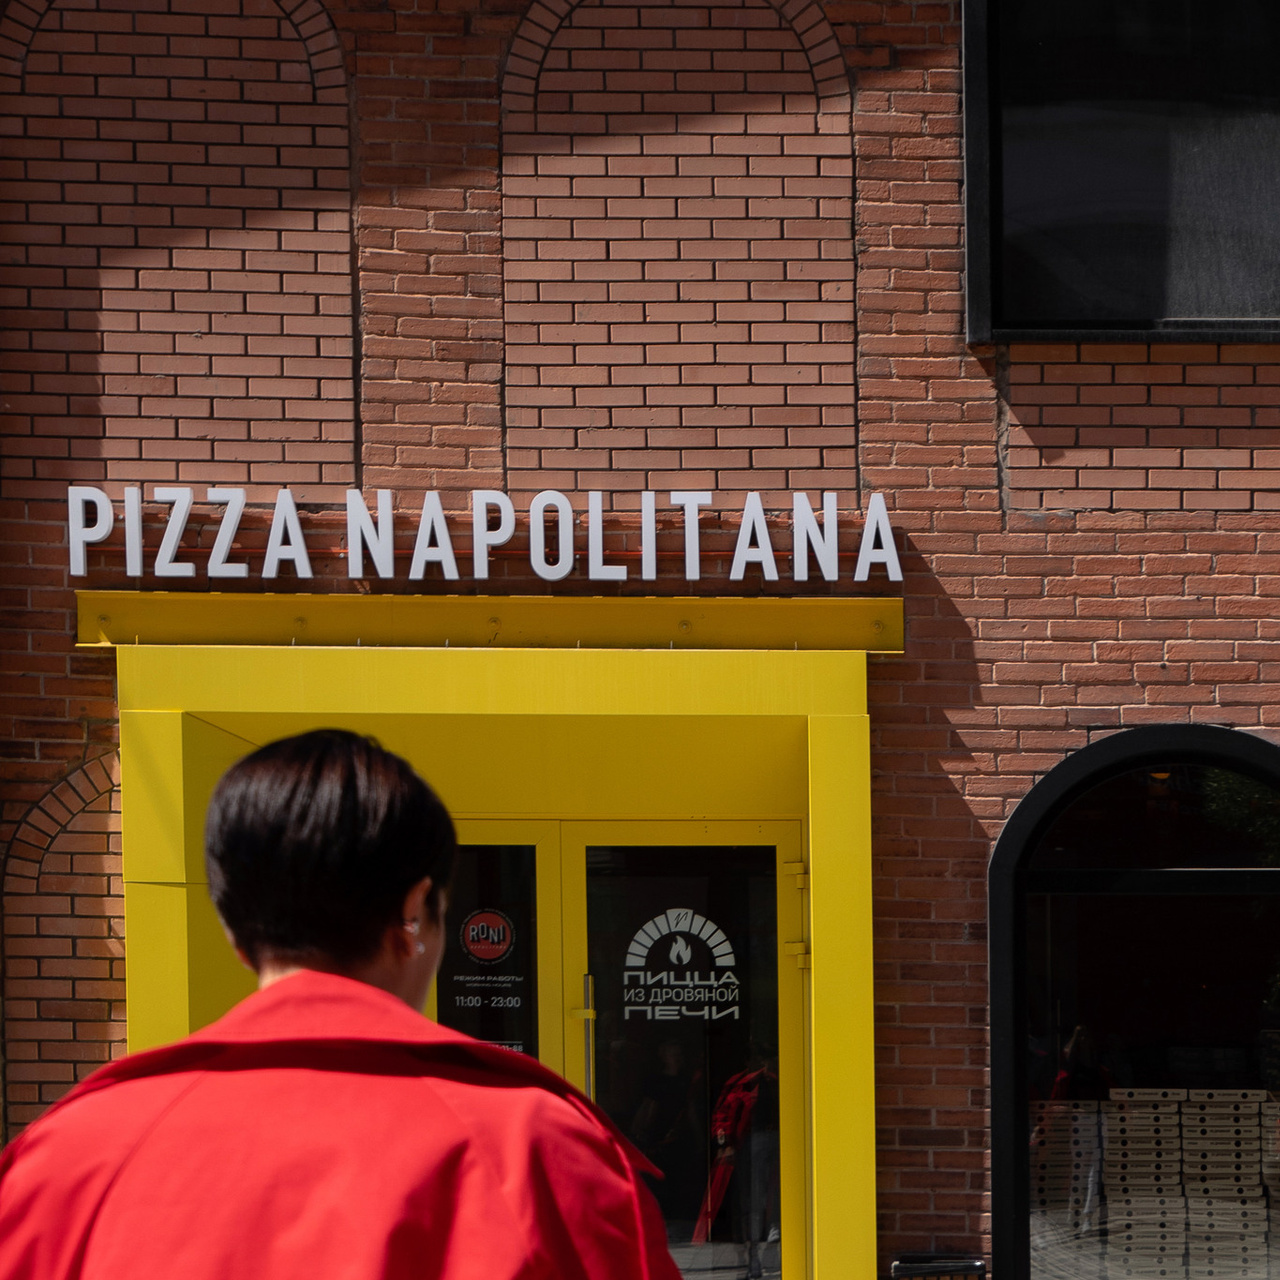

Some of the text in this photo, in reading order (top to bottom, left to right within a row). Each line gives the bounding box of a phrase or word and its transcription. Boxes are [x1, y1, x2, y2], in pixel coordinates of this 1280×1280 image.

[68, 486, 904, 582] PIZZA NAPOLITANA
[469, 922, 504, 943] RONI
[623, 971, 740, 987] ПИЦЦА
[455, 996, 482, 1007] 11:00
[490, 996, 521, 1007] 23:00
[624, 985, 739, 1003] ИЗ ДРОВЯНОЙ
[624, 1006, 739, 1019] ПЕЧИ
